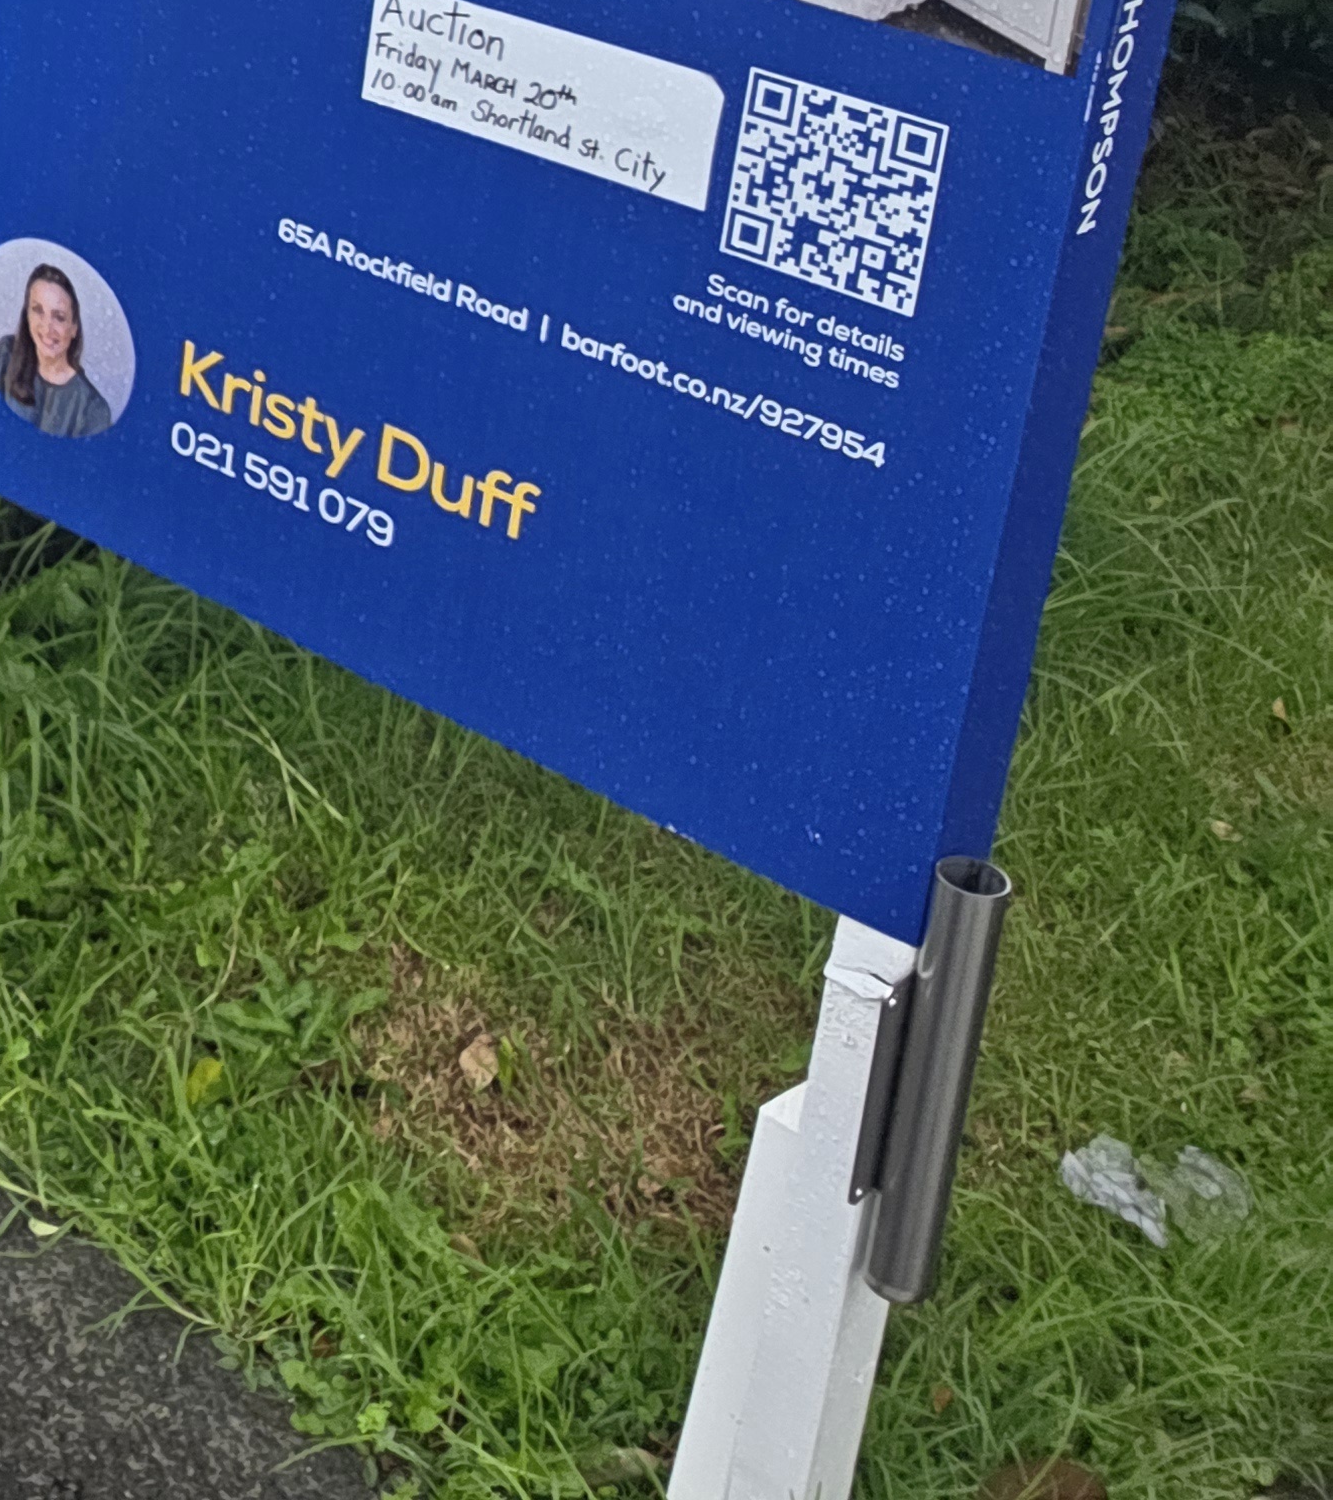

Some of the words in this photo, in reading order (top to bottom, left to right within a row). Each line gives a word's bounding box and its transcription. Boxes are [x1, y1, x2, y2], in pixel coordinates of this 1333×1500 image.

[375, 32, 442, 93] Friday
[451, 57, 518, 98] MARCH
[523, 81, 577, 110] 20th
[471, 99, 571, 150] Shortland
[615, 147, 666, 192] City
[278, 218, 332, 258] 65A
[335, 238, 452, 302] Rockfield
[455, 283, 529, 332] Road
[561, 323, 886, 468] barfoot.co.nz/927954
[673, 294, 723, 324] and
[727, 312, 823, 368] viewing
[828, 346, 900, 389] times
[706, 273, 769, 314] Scan
[775, 297, 814, 327] for
[816, 315, 905, 362] details
[171, 421, 236, 479] 021
[243, 452, 310, 512] 591
[318, 488, 395, 547] 079
[180, 339, 365, 478] Kristy
[377, 423, 542, 540] Duff
